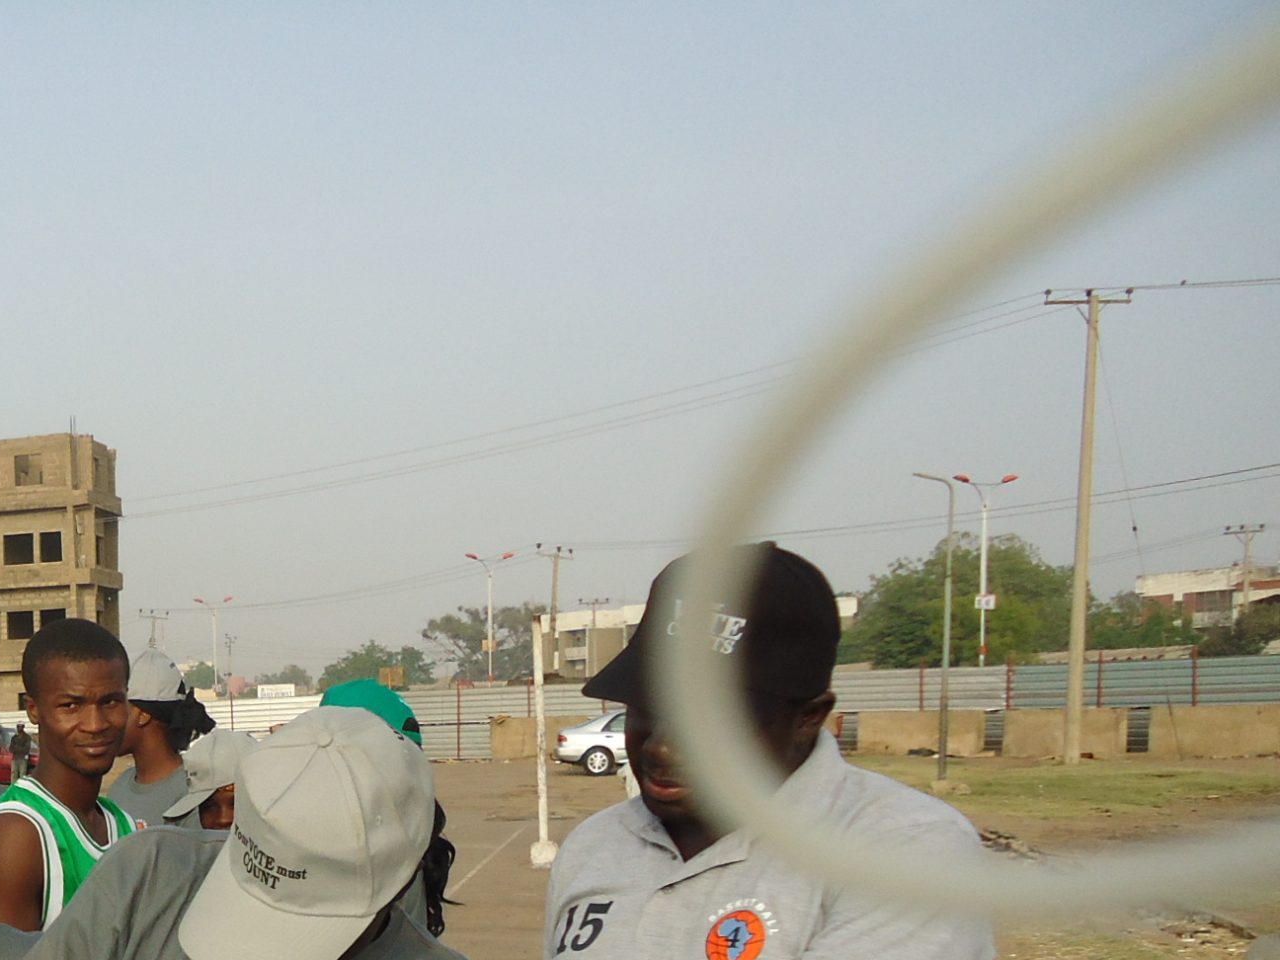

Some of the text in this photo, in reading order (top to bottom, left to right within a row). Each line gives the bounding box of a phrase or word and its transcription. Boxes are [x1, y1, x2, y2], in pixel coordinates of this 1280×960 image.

[243, 851, 281, 890] COUNT
[248, 836, 276, 871] VOTE
[276, 865, 308, 880] must
[556, 900, 614, 955] 15
[724, 926, 741, 949] 4
